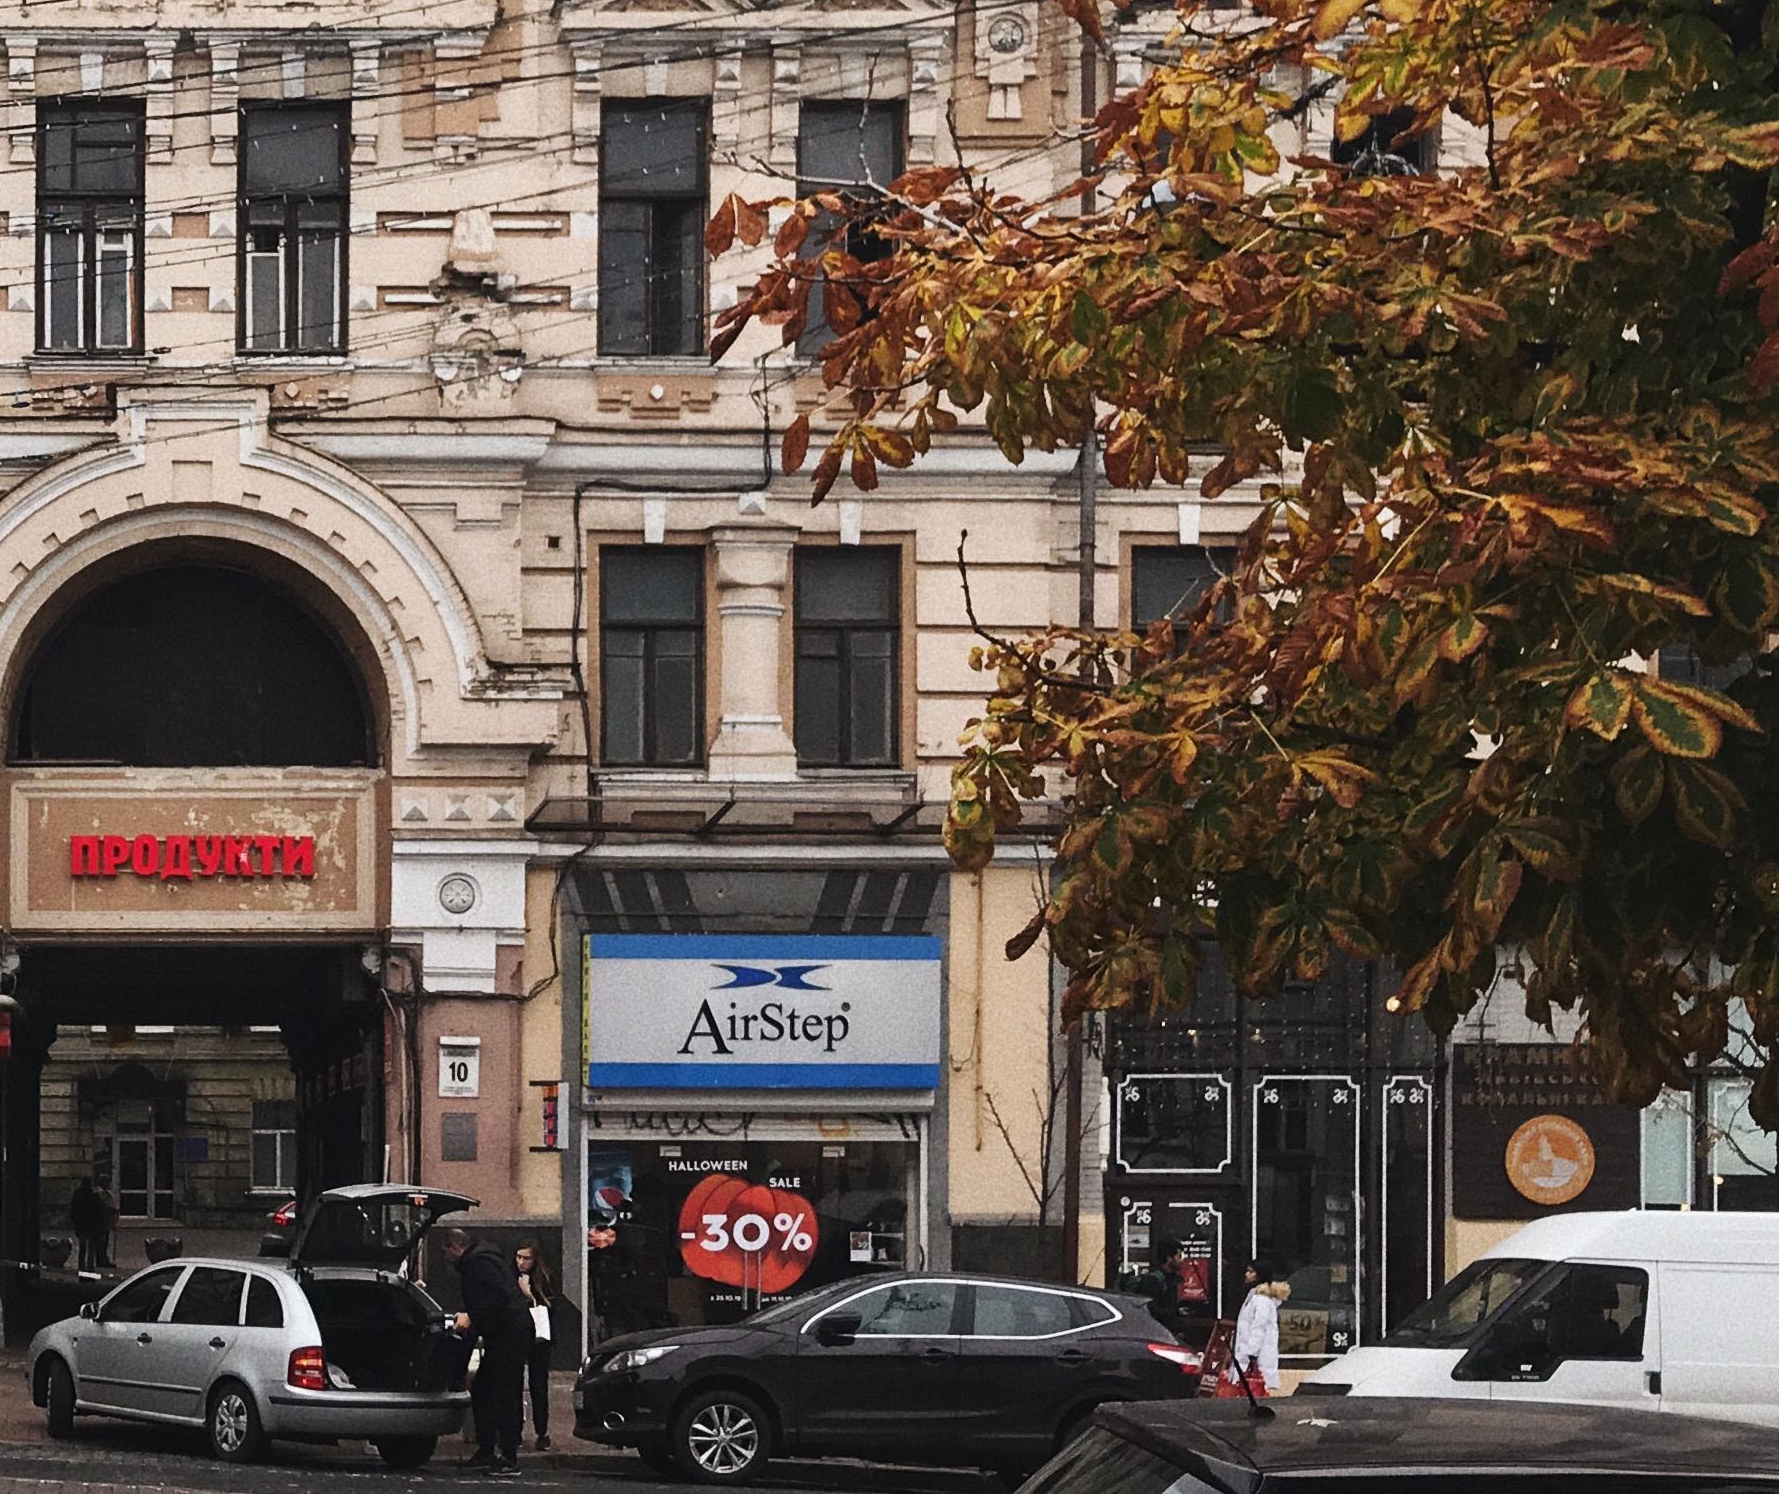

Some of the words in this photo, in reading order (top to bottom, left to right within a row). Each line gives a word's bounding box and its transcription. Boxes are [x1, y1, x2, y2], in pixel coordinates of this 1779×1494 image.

[70, 834, 315, 880] ПРОДУКТИ
[449, 1061, 468, 1082] 10
[669, 1160, 748, 1172] HALLOWEEN
[769, 1177, 801, 1188] SALE
[681, 1212, 813, 1251] -30%
